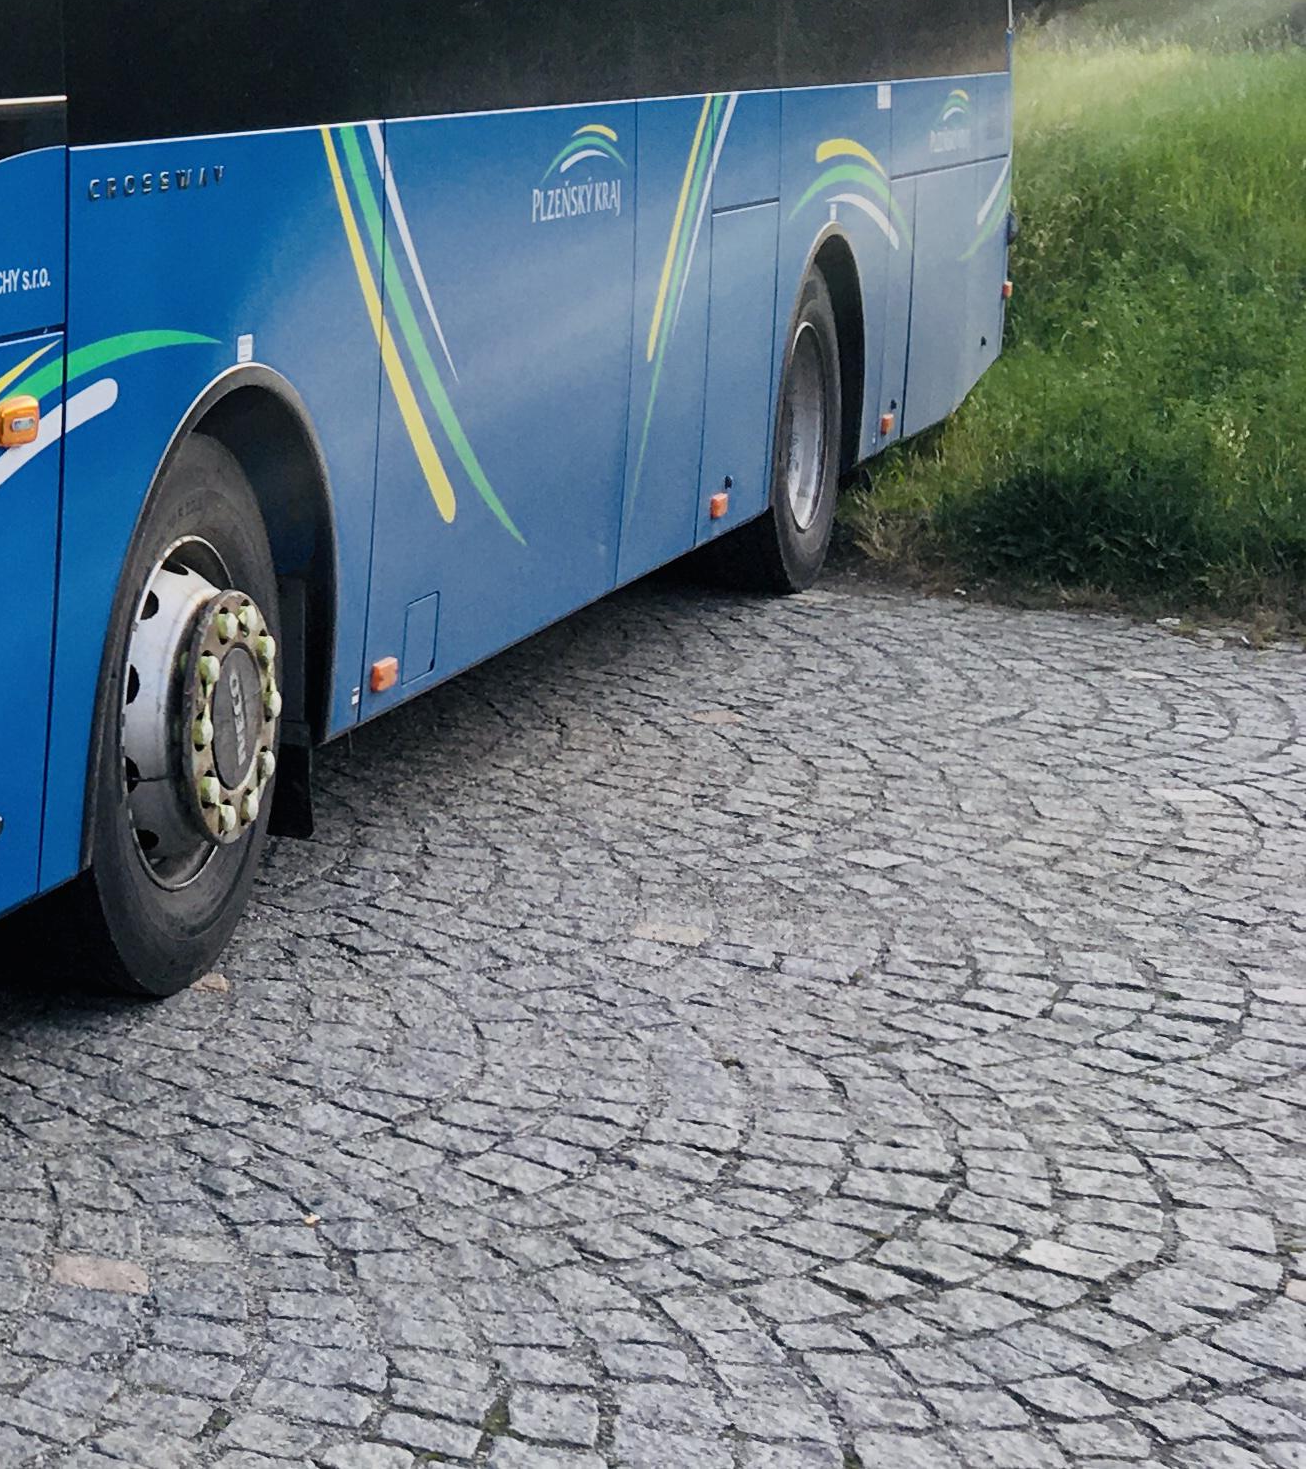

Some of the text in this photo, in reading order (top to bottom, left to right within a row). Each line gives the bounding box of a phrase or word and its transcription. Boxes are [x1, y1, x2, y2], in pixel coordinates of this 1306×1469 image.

[88, 165, 225, 200] CROSSWAY
[532, 176, 621, 223] PLZEŇSKÝ KRAJ
[21, 267, 52, 292] s.r.o.
